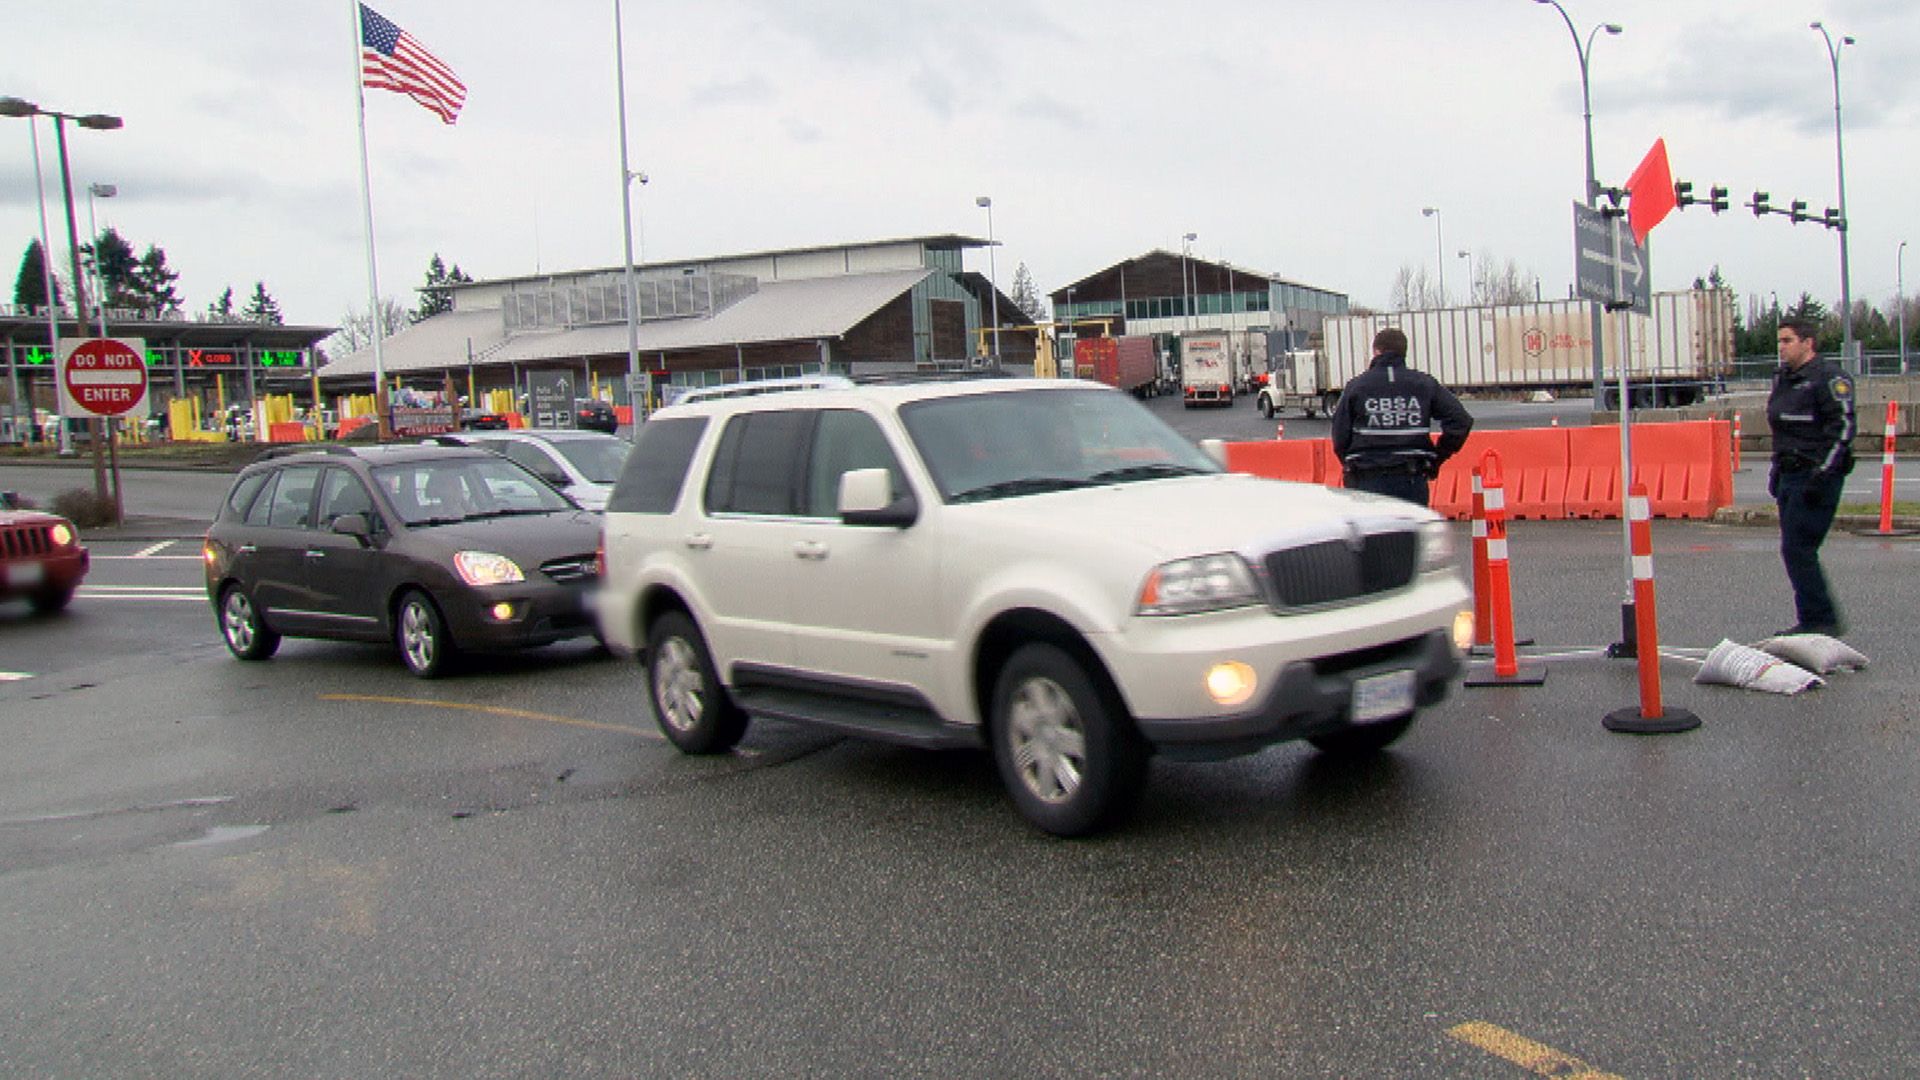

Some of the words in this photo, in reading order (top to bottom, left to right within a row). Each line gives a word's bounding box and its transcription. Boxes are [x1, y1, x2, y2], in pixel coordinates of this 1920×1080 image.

[75, 354, 96, 367] DO
[104, 354, 134, 367] NOT
[83, 388, 131, 401] ENTER
[1364, 396, 1421, 411] CBSA
[1366, 412, 1422, 427] ASFC
